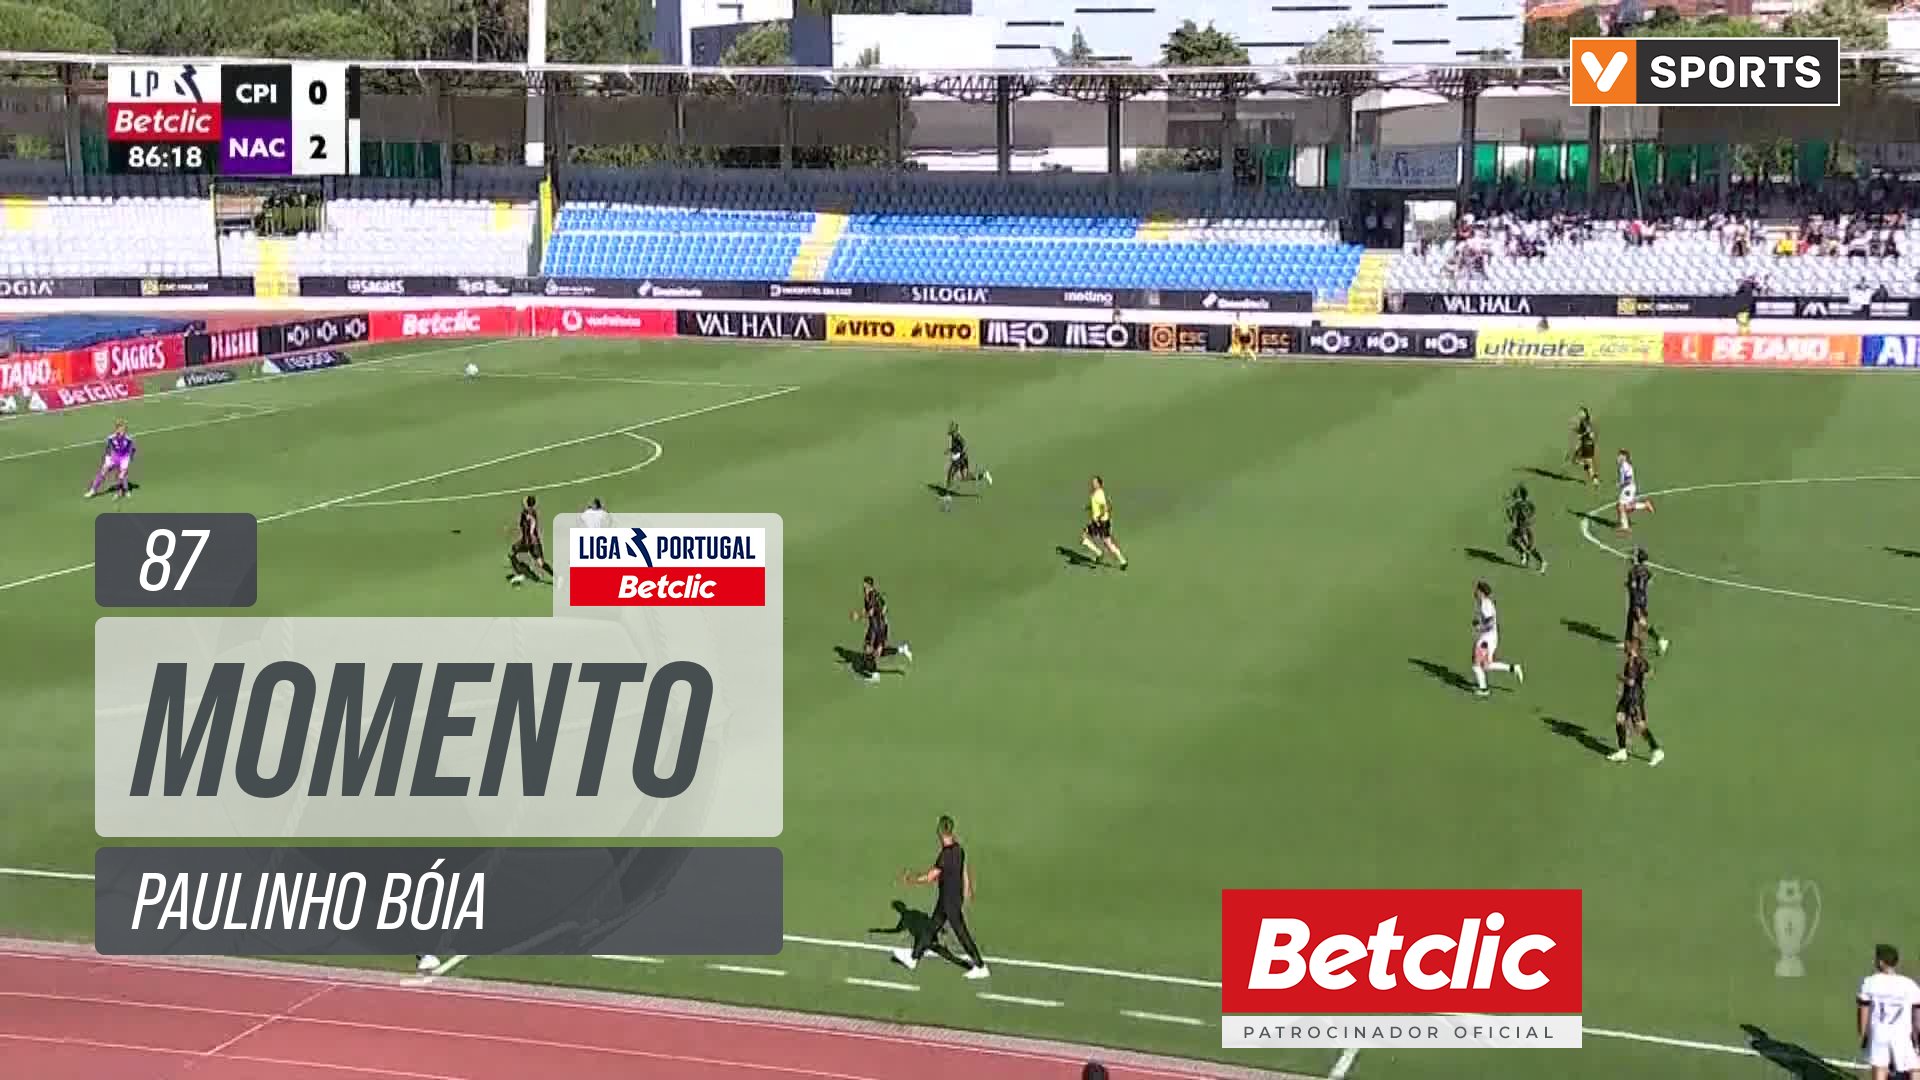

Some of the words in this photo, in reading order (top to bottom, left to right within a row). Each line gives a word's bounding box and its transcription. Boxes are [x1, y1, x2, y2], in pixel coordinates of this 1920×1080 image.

[911, 287, 987, 302] SILOGIA
[402, 312, 480, 336] Betclic
[987, 322, 1049, 344] MEO
[1065, 323, 1129, 346] MEO
[111, 341, 166, 375] SAGRES
[57, 382, 128, 405] Betclic
